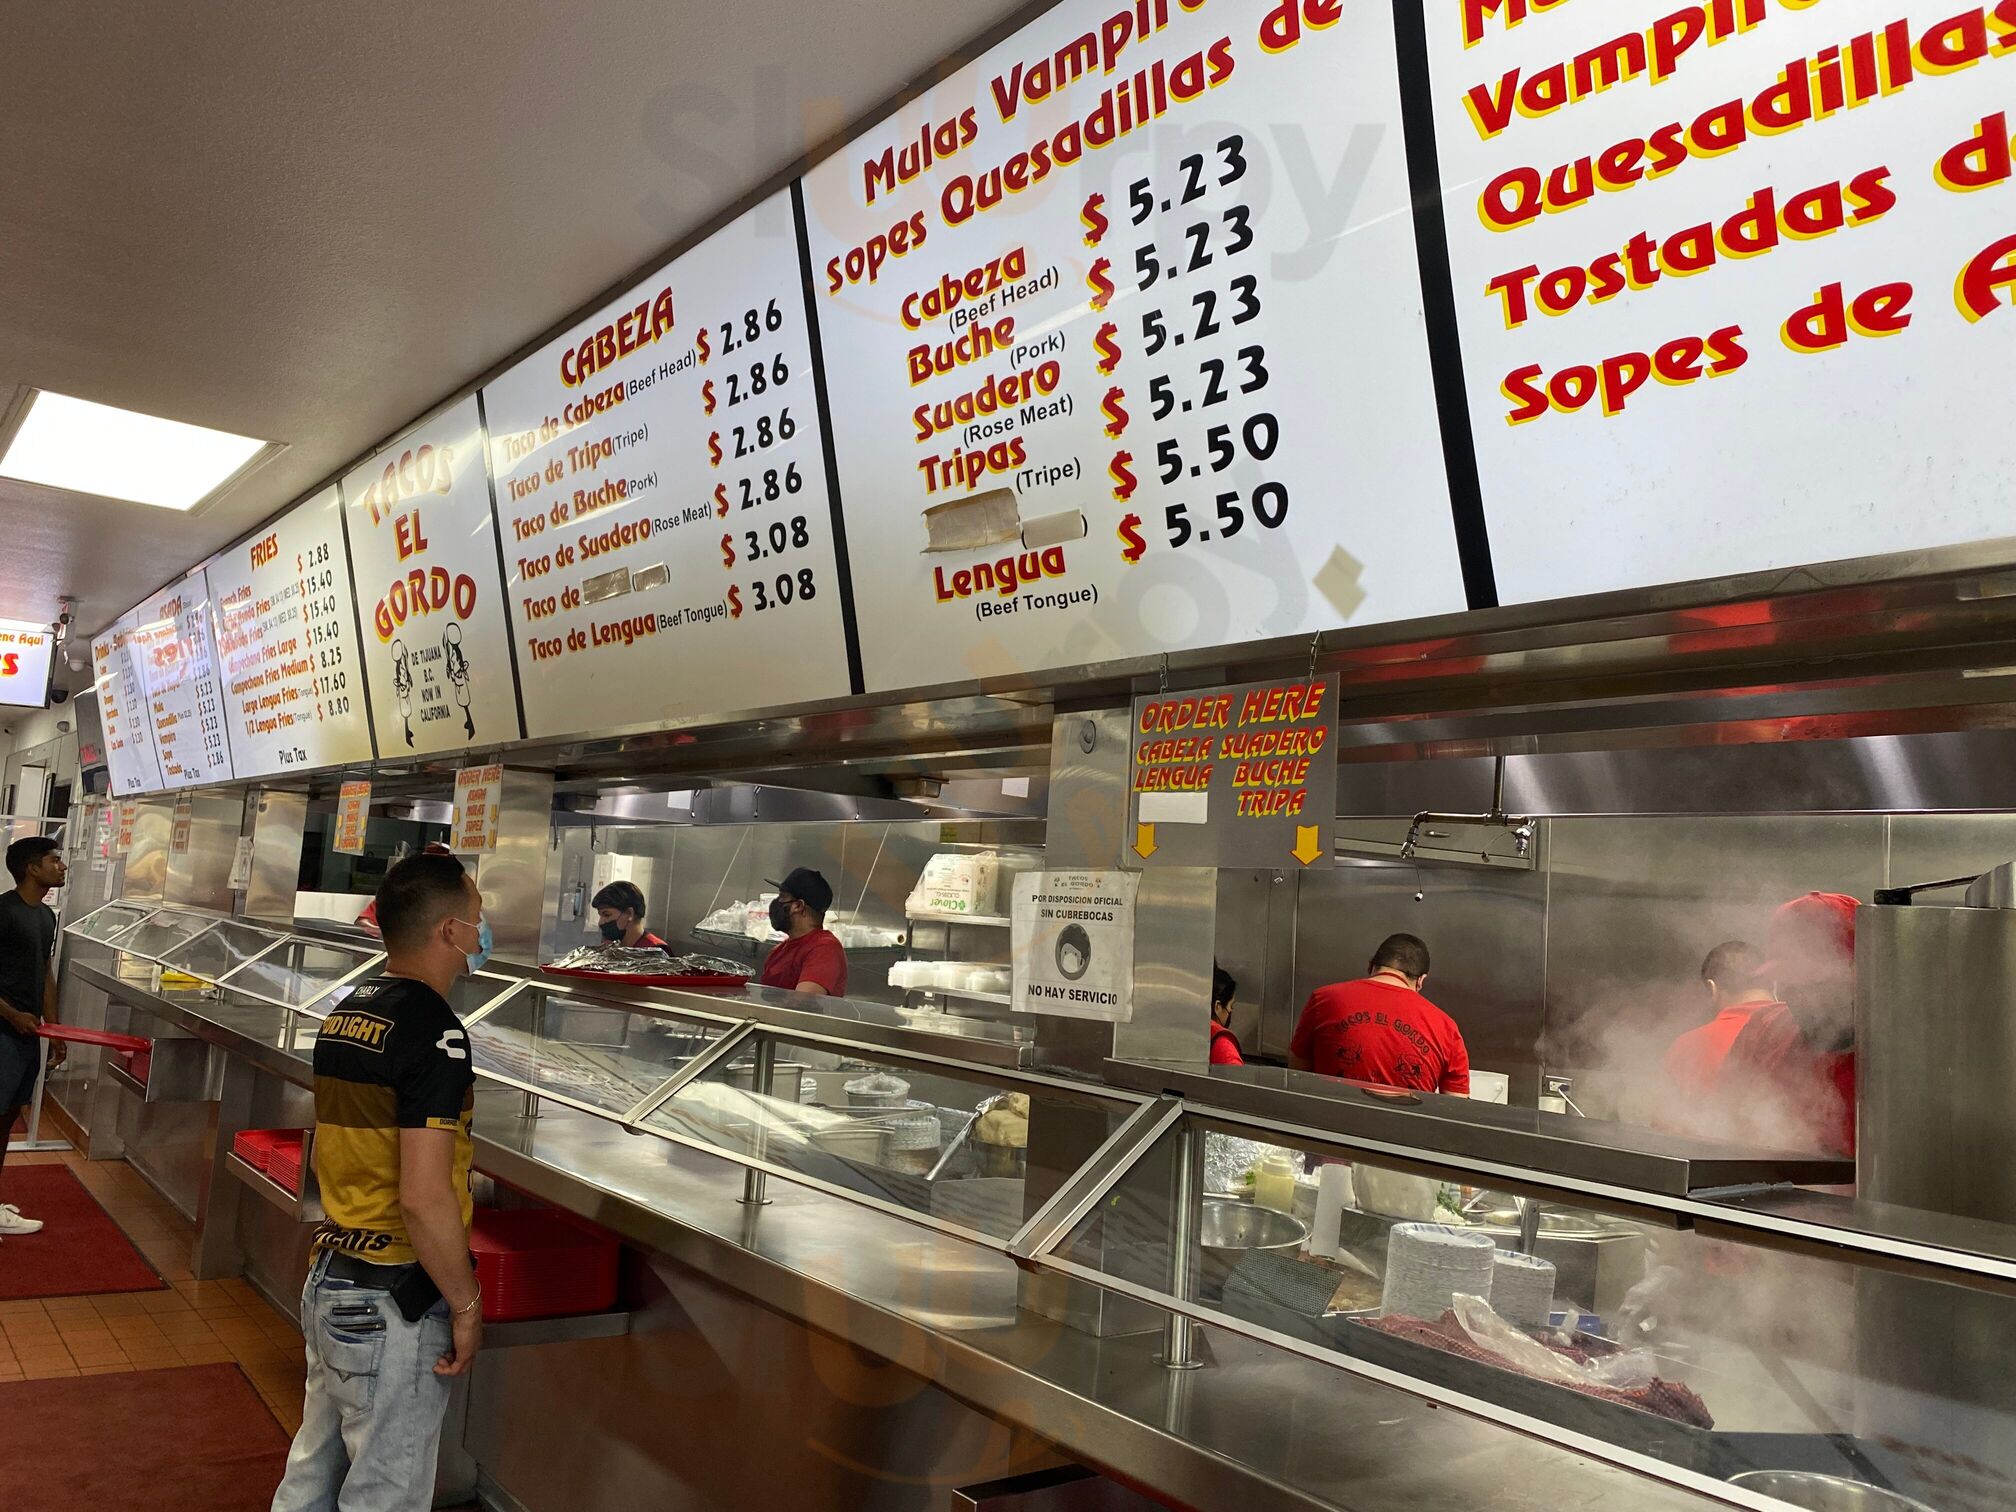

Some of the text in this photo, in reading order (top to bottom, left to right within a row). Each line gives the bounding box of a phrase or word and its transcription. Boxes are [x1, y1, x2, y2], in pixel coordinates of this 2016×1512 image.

[941, 36, 1235, 228] Quesadillas
[862, 104, 979, 206] Mulas
[900, 134, 1248, 330] Cabeza $ 5.23
[1486, 111, 2016, 330] Tostadas d
[907, 204, 1254, 387] Buche $ 5.23
[948, 265, 1060, 335] (Beef Head)
[560, 286, 675, 389] CABEZA
[911, 273, 1261, 444] Suadero $ 5.23
[1010, 330, 1066, 370] (Pork)
[1500, 281, 1914, 426] Sopes de
[539, 416, 560, 444] de
[563, 381, 625, 427] Cabeza
[625, 368, 656, 401] (Beef
[659, 349, 697, 381] Head)
[696, 327, 711, 366] $
[720, 298, 782, 356] 2.86
[508, 352, 789, 501] Taco de Tripa (Tripe) $ 2.86
[917, 344, 1269, 494] Tripas $ 5.23
[962, 393, 1074, 449] (Rose Meat)
[512, 407, 796, 543] Taco de Buche (Pork) $ 2.86
[1015, 456, 1082, 495] (Tripe)
[1107, 412, 1280, 502] $ 5.50
[364, 444, 454, 528] TACOS
[393, 508, 428, 562] EL
[518, 461, 802, 581] Taco de Suadero (Rose Meat) $ 2.86
[933, 480, 1289, 604] Lengua $ 5.50
[250, 533, 279, 573] FRIES
[308, 543, 330, 568] 2.88
[523, 515, 809, 623] Taco de $ 3.08
[256, 599, 271, 618] Fries
[306, 569, 332, 595] 15.40
[309, 595, 336, 620] 15.40
[374, 566, 477, 645] GORDO
[528, 568, 816, 661] Taco de Lengua (Beef Tongue) $ 3.08
[974, 583, 1099, 622] (Beef Tongue)
[19, 634, 44, 648] Aqui
[262, 646, 277, 663] Fries
[278, 638, 297, 656] Large
[313, 621, 339, 645] 15.40
[420, 645, 442, 663] TIJUANA
[265, 668, 280, 684] Fries
[280, 658, 309, 679] Medium
[309, 653, 316, 673] $
[320, 646, 342, 669] 8.25
[200, 680, 213, 697] 5.23
[202, 698, 215, 714] 5.23
[242, 671, 346, 715] Large Lengua Fries $ 17.60
[1139, 681, 1327, 734] ORDER HERE
[205, 716, 218, 732] 5.23
[255, 717, 278, 735] Lengua
[278, 712, 294, 729] Fries
[317, 703, 323, 722] $
[328, 696, 350, 716] 8.80
[420, 704, 451, 722] CALIFORNIA
[208, 733, 221, 749] 5.23
[278, 747, 307, 764] Plus Tax
[1136, 725, 1328, 766] CABEZA SUADERO
[458, 767, 502, 787] ORDER HERE
[1132, 757, 1311, 793] LENGUA BUCHE
[1237, 788, 1307, 817] TRIPA
[930, 898, 958, 911] Clover
[1031, 894, 1123, 906] POR DISPOSICION OFICIAL
[1041, 909, 1113, 922] SIN CUBREBOCAS
[1028, 984, 1118, 1005] NO HAY SERVICIO
[339, 1016, 386, 1045] LIGHT
[1335, 1010, 1430, 1054] TACOS EL GORDO
